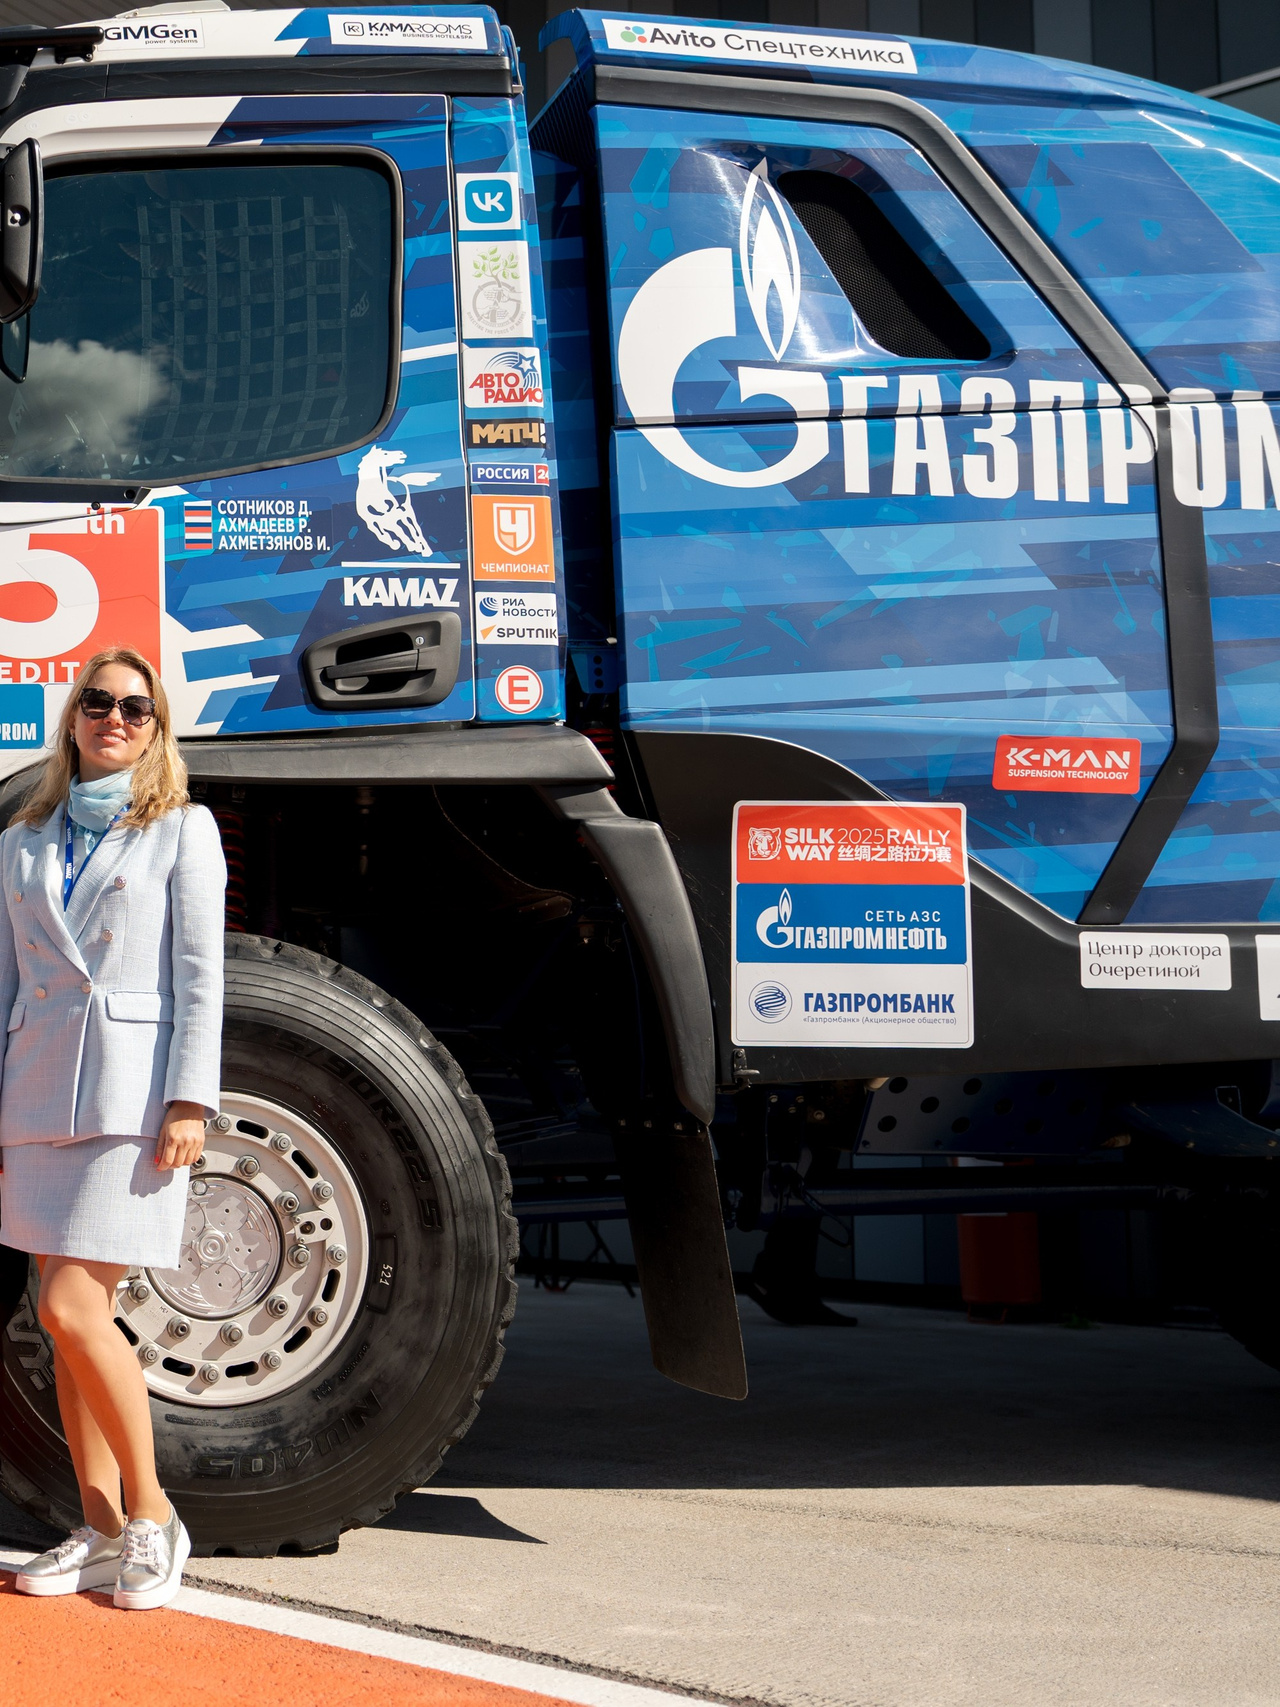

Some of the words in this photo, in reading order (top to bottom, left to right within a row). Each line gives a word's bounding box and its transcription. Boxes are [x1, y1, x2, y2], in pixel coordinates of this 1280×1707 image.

[104, 24, 198, 40] GMGen
[368, 22, 473, 35] KAMAROOMS
[649, 28, 716, 49] Avito
[724, 33, 905, 65] Спецтехника
[472, 191, 506, 212] VK
[469, 372, 520, 389] АВТО
[484, 387, 543, 404] РАДИО
[477, 467, 530, 480] РОССИЯ
[218, 500, 295, 516] СОТНИКОВ
[298, 500, 313, 518] Д.
[218, 517, 295, 534] АХМАДЕЕВ
[298, 518, 312, 533] Р.
[218, 535, 313, 550] АХМЕТЗЯНОВ
[316, 536, 331, 551] И.
[481, 563, 550, 574] ЧЕМПИОНАТ
[343, 576, 460, 608] KAMAZ
[502, 598, 526, 607] РИА
[507, 675, 530, 705] E
[1006, 747, 1131, 769] K-MAN
[1008, 768, 1065, 779] SUSPENSION
[1066, 770, 1129, 780] TECHNOLOGY
[784, 827, 834, 844] SILK
[785, 845, 834, 861] WAY
[837, 846, 952, 863] 丝绸之路拉力赛
[865, 910, 906, 922] СЕТЬ
[910, 910, 941, 922] АЗС
[795, 926, 947, 950] ГАЗПРОМНЕФТЬ
[1088, 941, 1143, 959] Центр
[1149, 944, 1222, 960] доктора
[1089, 962, 1200, 980] Очеретиной
[804, 992, 955, 1014] ГАЗПРОМБАНК
[803, 1015, 860, 1025] «Газпромбанк»
[861, 1016, 916, 1026] (Акционерное
[917, 1017, 957, 1026] общество)
